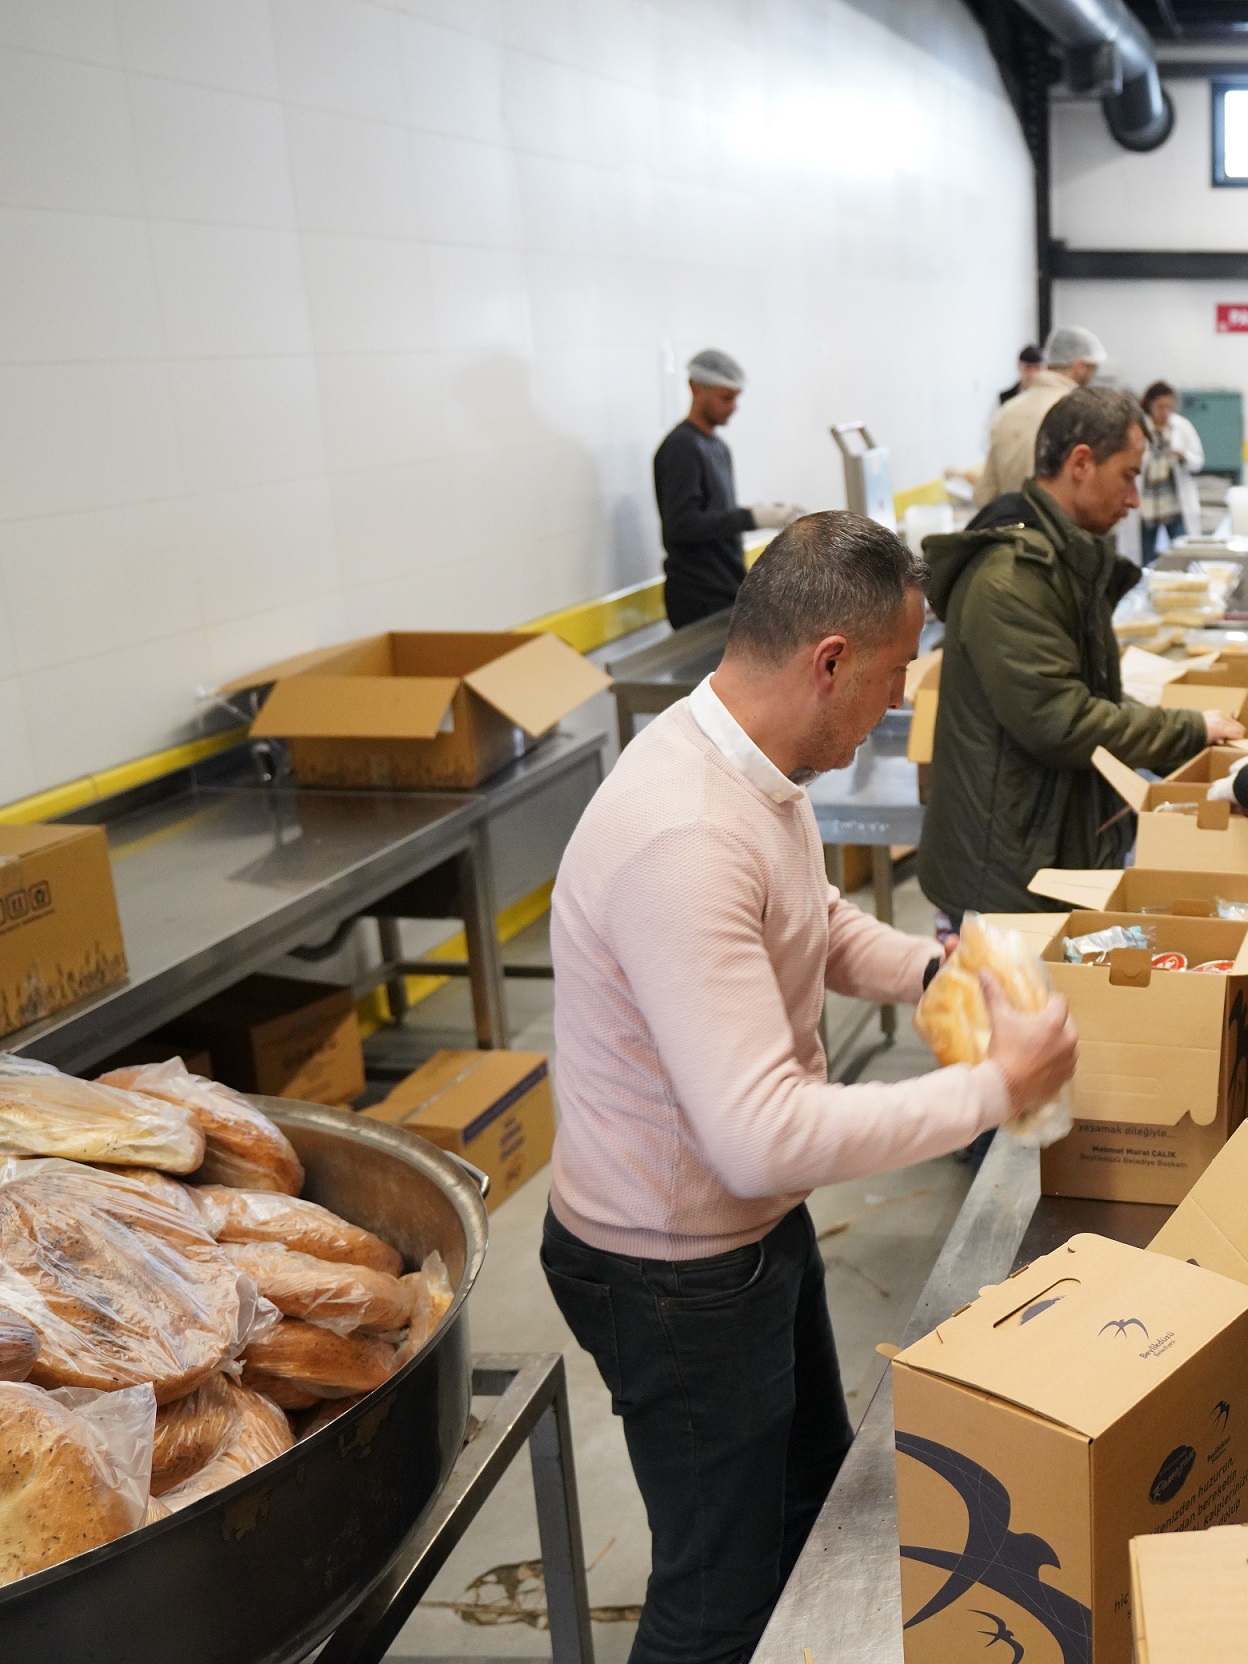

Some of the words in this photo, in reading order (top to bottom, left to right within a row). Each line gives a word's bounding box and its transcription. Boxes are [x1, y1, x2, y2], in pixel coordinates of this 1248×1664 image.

[1079, 1123, 1123, 1134] yaşamak
[1125, 1126, 1176, 1138] dileğiyle...
[1092, 1145, 1124, 1155] Mehmet
[1126, 1147, 1150, 1157] Murat
[1139, 1331, 1175, 1358] Beylikdüzü
[1197, 1457, 1234, 1498] huzurun,
[1198, 1470, 1237, 1516] bereketin
